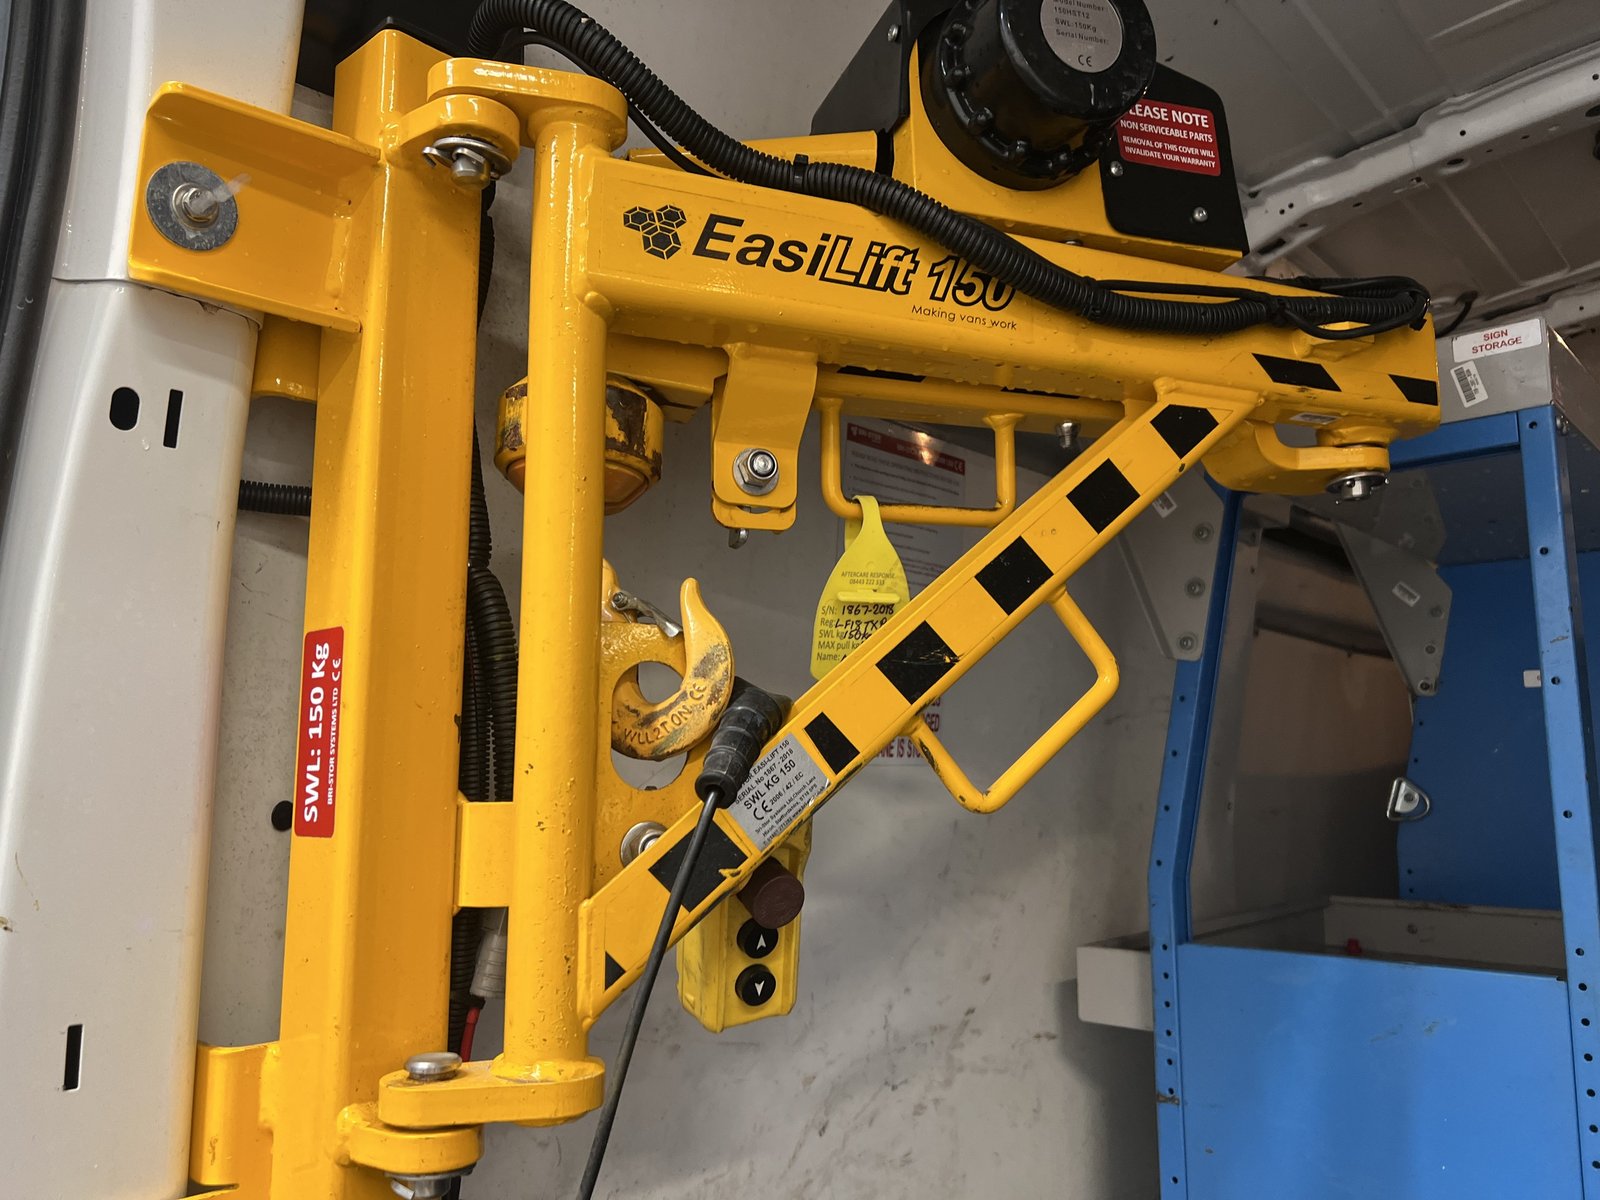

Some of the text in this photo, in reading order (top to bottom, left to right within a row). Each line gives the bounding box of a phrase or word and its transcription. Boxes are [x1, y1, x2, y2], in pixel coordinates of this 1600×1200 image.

[1055, 28, 1078, 39] Serial
[1171, 110, 1209, 128] NOTE
[1120, 119, 1213, 143] NON SERVICEABLE PARTS
[1122, 135, 1215, 158] REMOVAL OF THIS COVER WILL
[1124, 146, 1215, 168] INVALIDATE YOUR WARRANTY
[927, 254, 1016, 311] 150
[911, 304, 1017, 331] Making vans work
[1471, 336, 1522, 354] STORAGE
[1483, 329, 1508, 341] SIGN
[870, 571, 896, 579] RESPONSE
[821, 602, 894, 616] S/N: 1867-2018
[818, 629, 834, 639] SWL
[817, 652, 840, 661] Name:
[818, 640, 835, 650] MAX
[836, 640, 850, 652] pull
[304, 642, 330, 823] SWL: 150 Kg
[330, 707, 338, 755] SYSTEMS
[752, 747, 779, 775] EASI-LIFT
[754, 774, 765, 785] No
[779, 748, 794, 763] 2018
[327, 756, 336, 805] BRI-STOR
[742, 788, 767, 810] SWL
[763, 773, 780, 791] KG
[778, 759, 796, 776] 150
[768, 790, 784, 806] 2006
[784, 781, 794, 791] 42
[794, 771, 804, 782] EC
